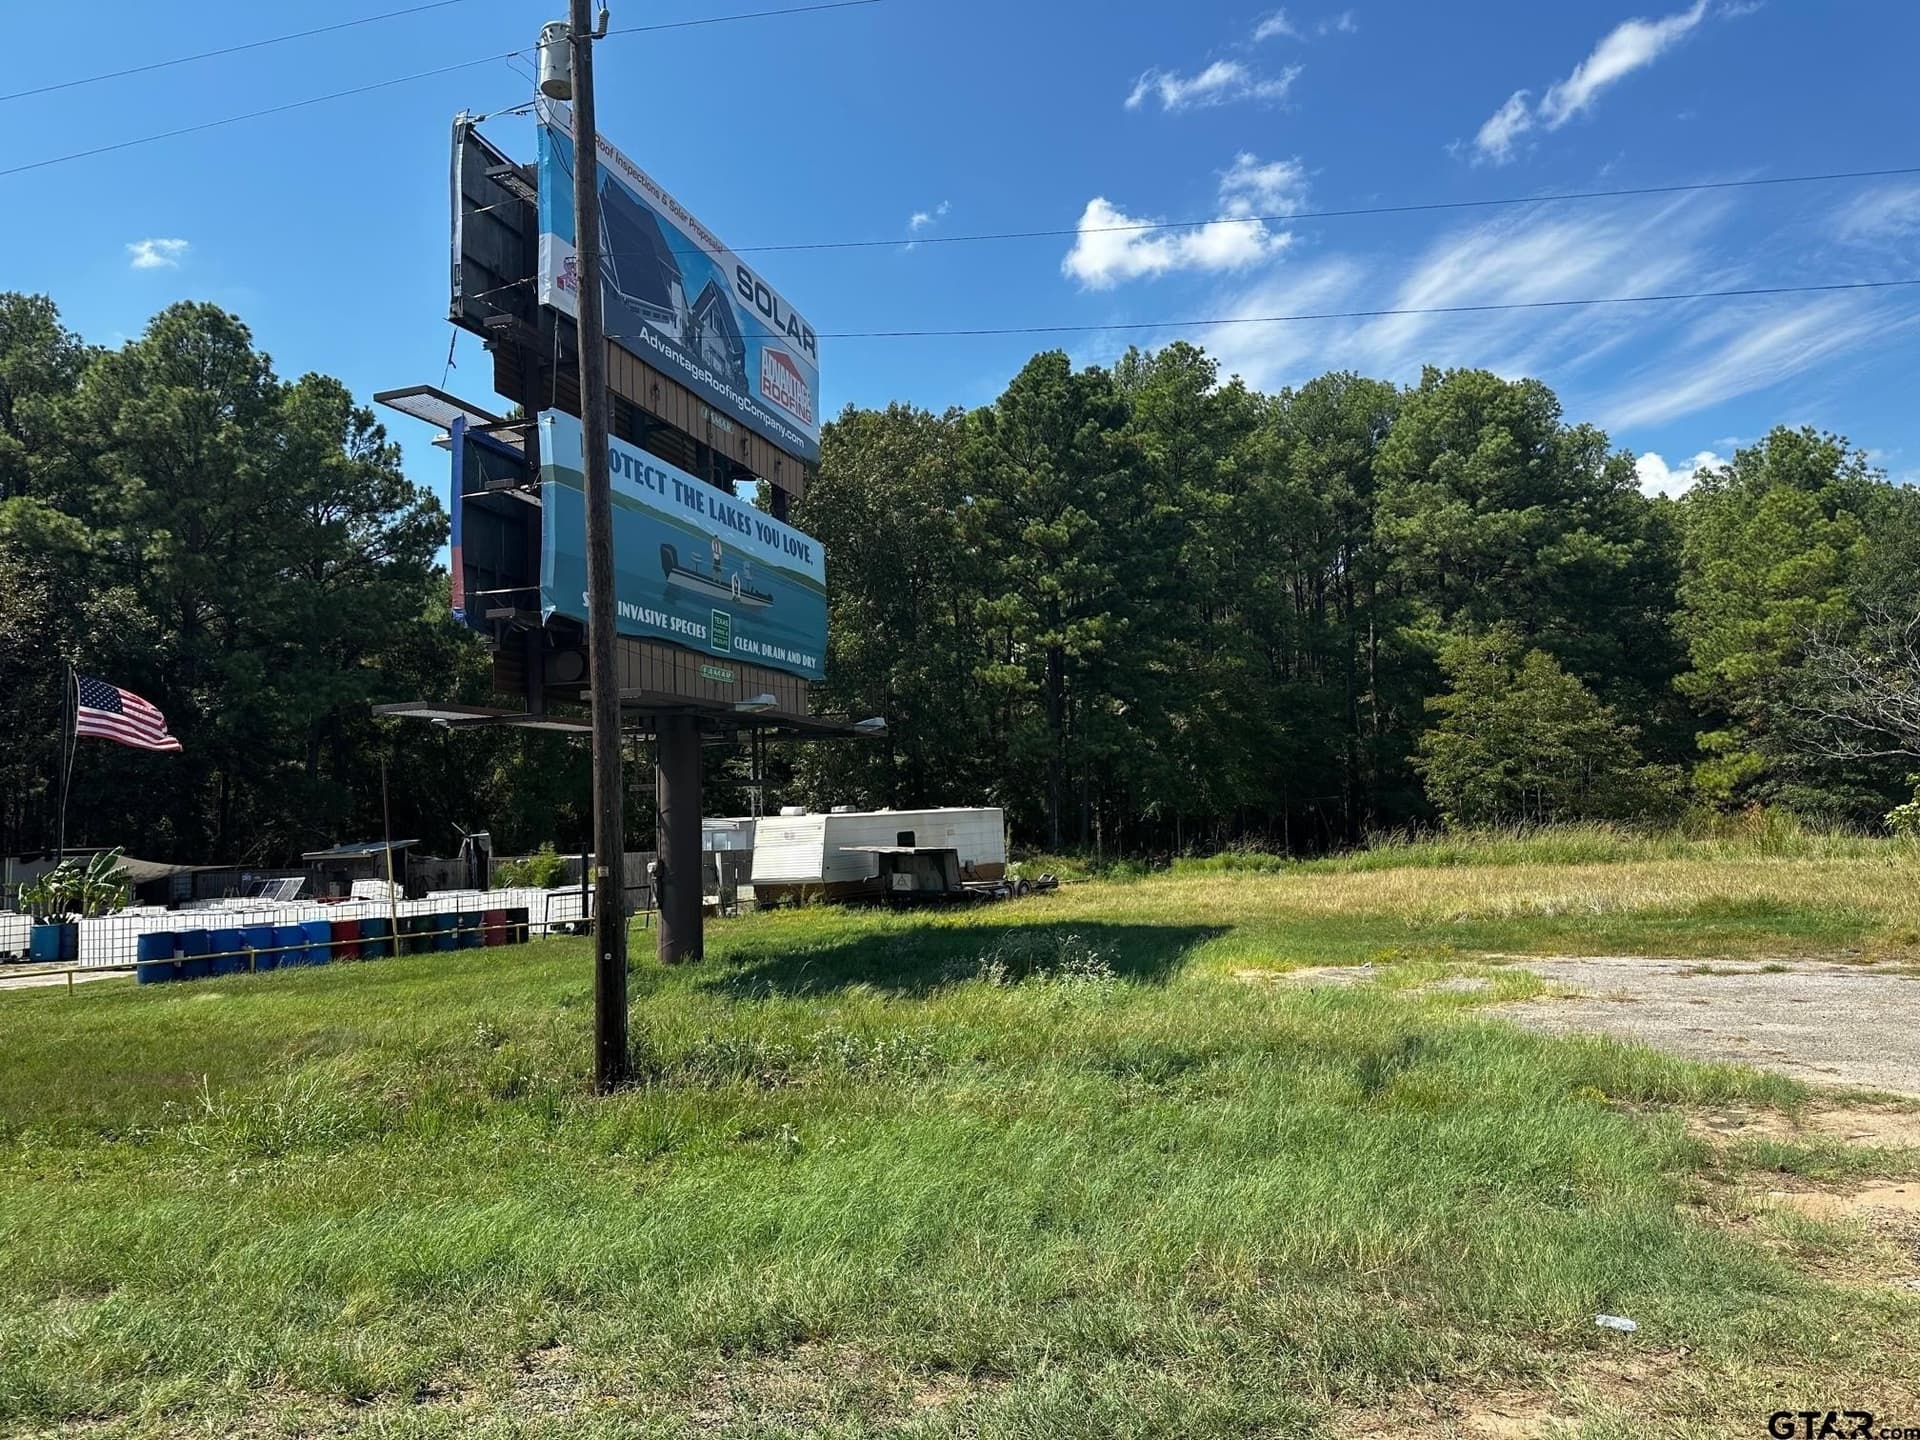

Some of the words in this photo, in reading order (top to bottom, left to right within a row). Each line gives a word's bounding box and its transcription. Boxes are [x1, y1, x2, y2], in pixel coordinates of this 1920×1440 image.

[595, 136, 614, 159] Roof
[616, 152, 660, 200] Inspections
[662, 194, 668, 206] &
[669, 200, 688, 222] Solar
[736, 264, 816, 360] SOLAR
[639, 325, 805, 448] AdvantageRoofingCompany.com
[762, 376, 812, 423] ROOFING
[672, 478, 704, 514] THE
[709, 497, 751, 536] LAKES
[756, 520, 779, 548] YOU
[783, 534, 813, 565] LOVE.
[617, 600, 667, 628] INVASIVE
[670, 616, 706, 639] SPECIES
[734, 636, 760, 655] CLEAN,
[762, 643, 785, 660] DRAIN
[787, 650, 801, 664] AND
[802, 654, 816, 669] DRY
